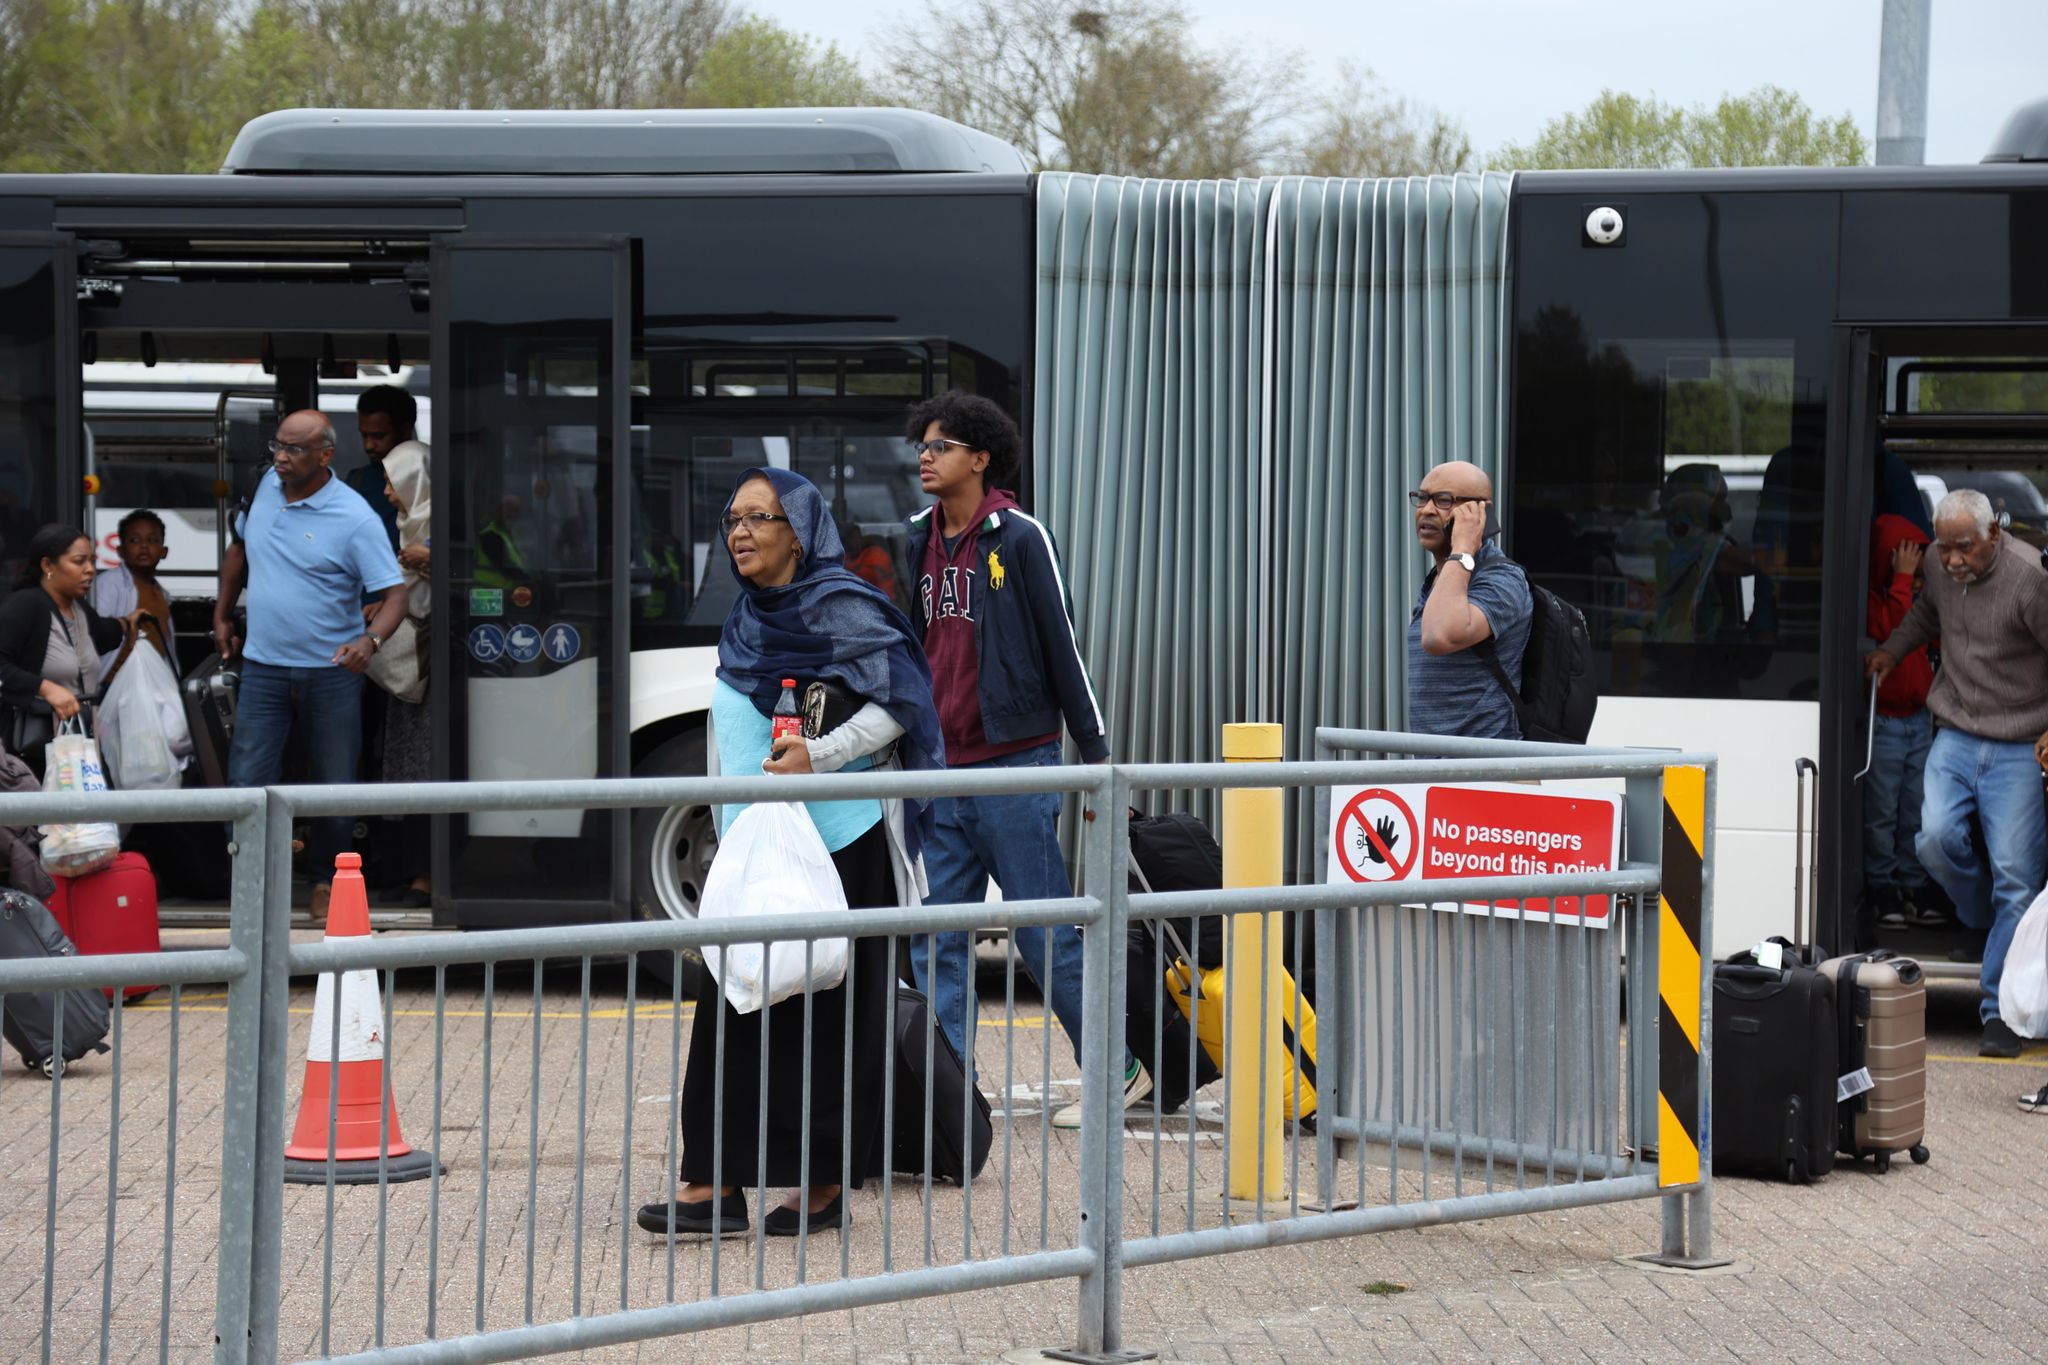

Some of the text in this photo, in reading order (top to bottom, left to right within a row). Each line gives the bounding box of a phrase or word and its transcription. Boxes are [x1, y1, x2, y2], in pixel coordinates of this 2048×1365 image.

[1432, 817, 1583, 853] No passengers
[1430, 846, 1505, 874] beyond
[1510, 854, 1548, 875] this
